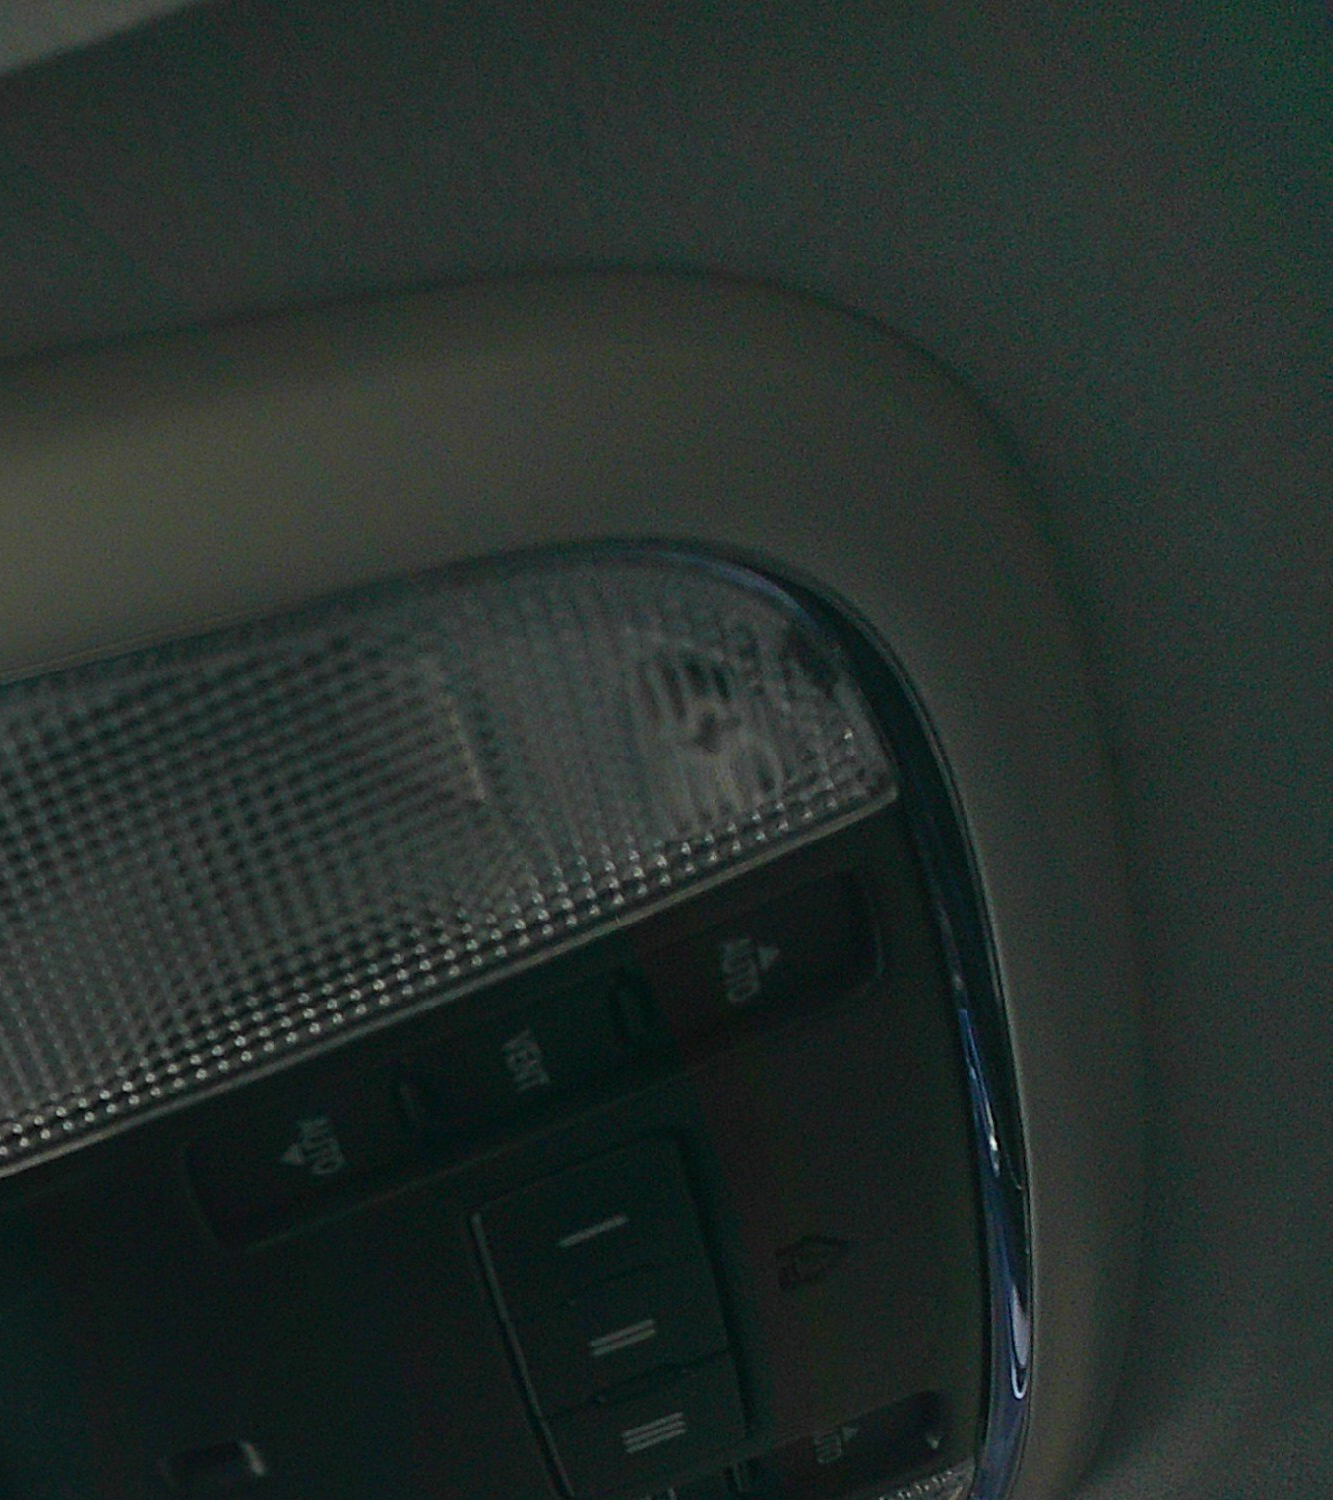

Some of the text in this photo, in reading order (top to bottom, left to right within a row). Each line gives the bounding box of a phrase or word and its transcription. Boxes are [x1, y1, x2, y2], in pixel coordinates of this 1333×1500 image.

[716, 935, 764, 1004] AUTO
[501, 1026, 552, 1094] VENT
[298, 1115, 346, 1177] AUTO
